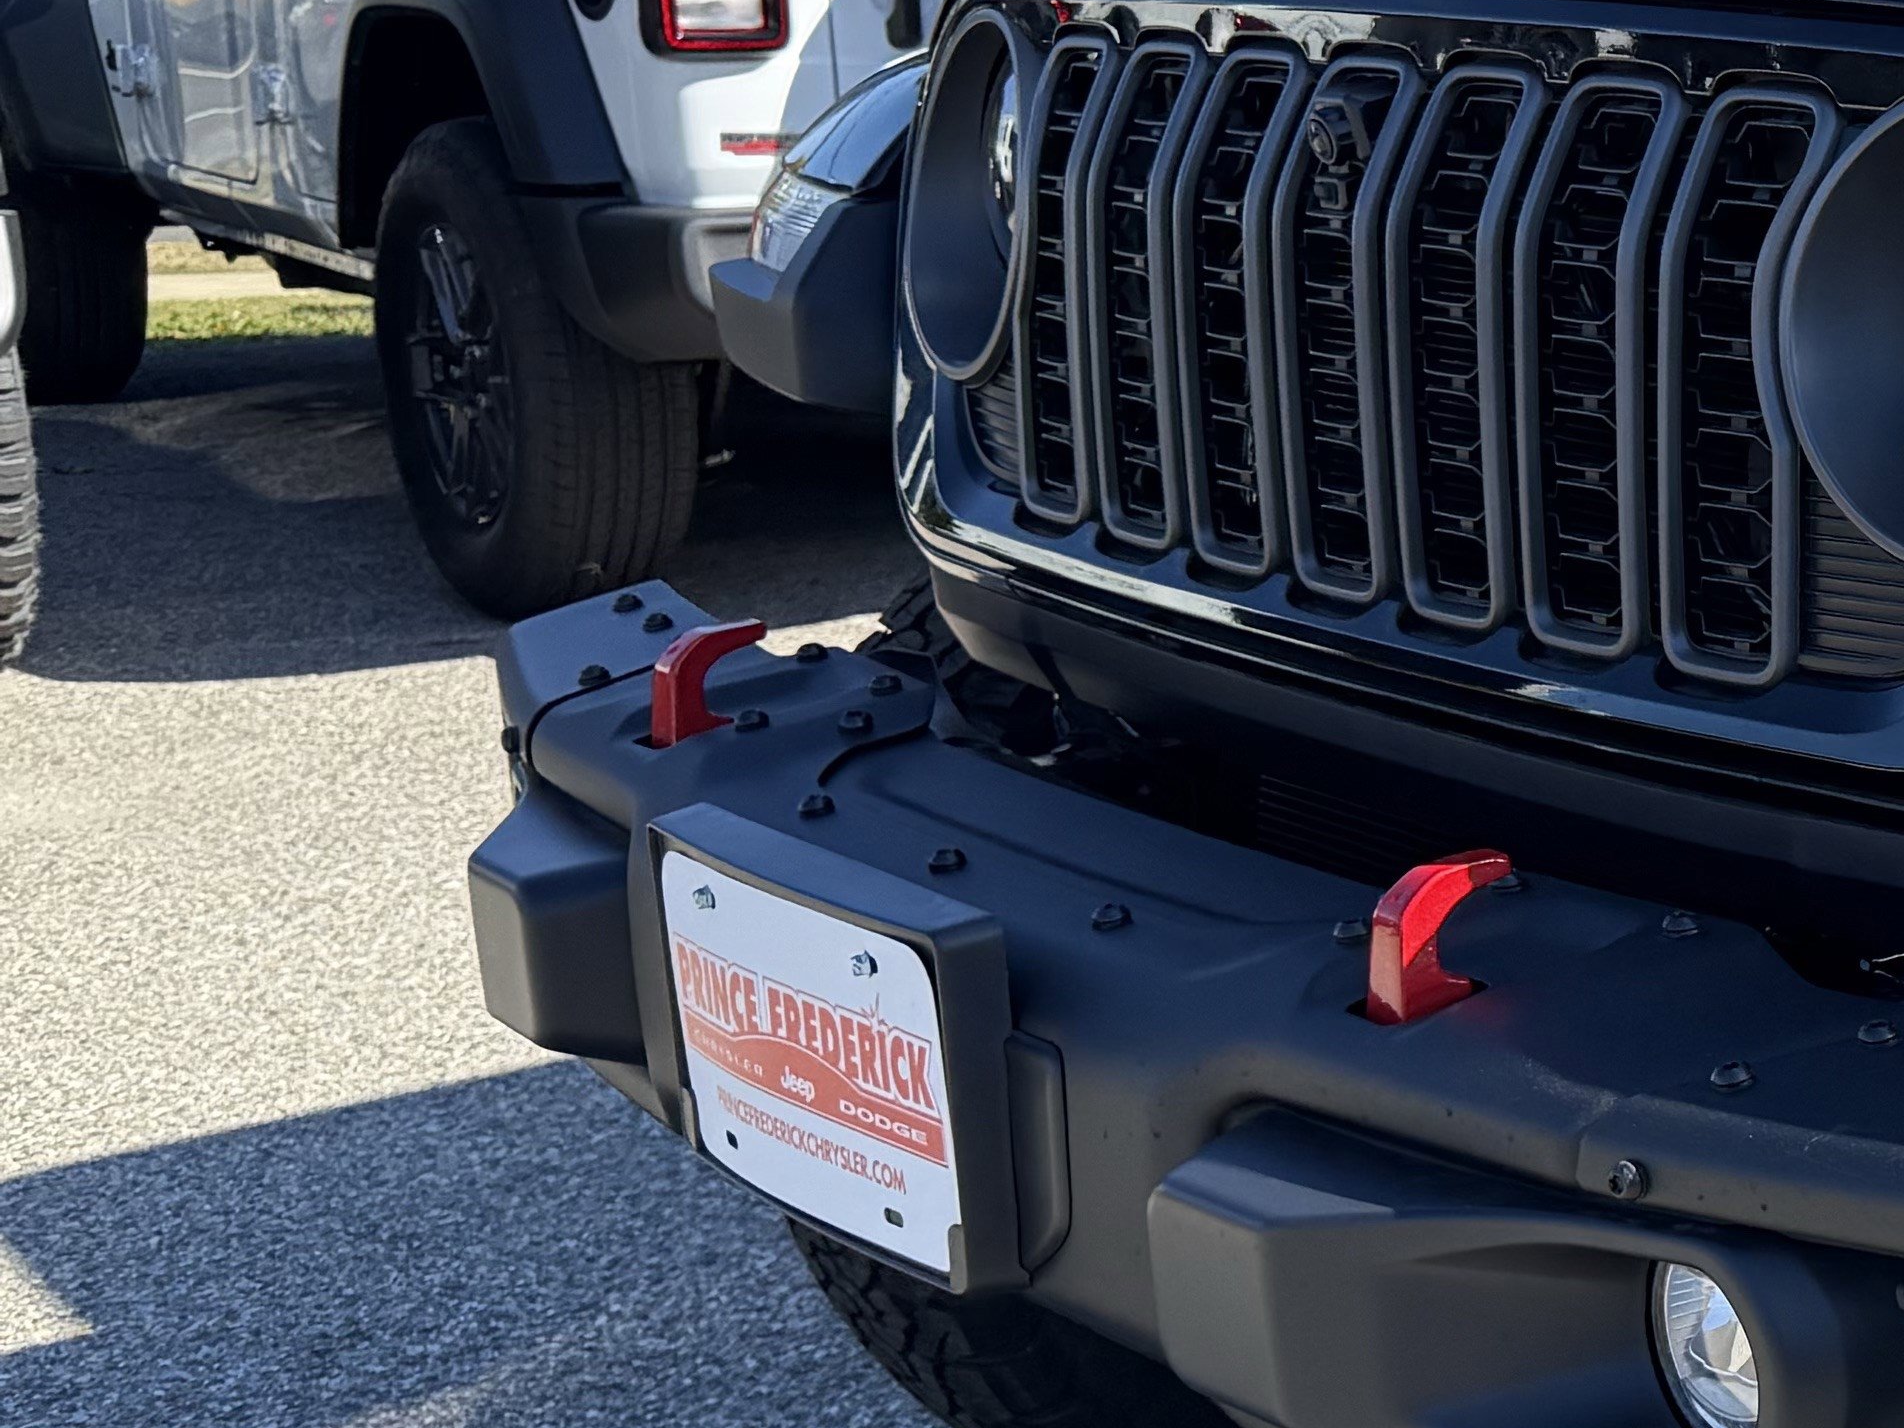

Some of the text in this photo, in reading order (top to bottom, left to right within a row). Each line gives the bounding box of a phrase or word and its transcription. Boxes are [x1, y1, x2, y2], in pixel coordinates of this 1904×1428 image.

[675, 940, 933, 1109] PRINCE FREDERICK
[780, 1064, 816, 1103] Jeep
[839, 1098, 929, 1147] DODGE
